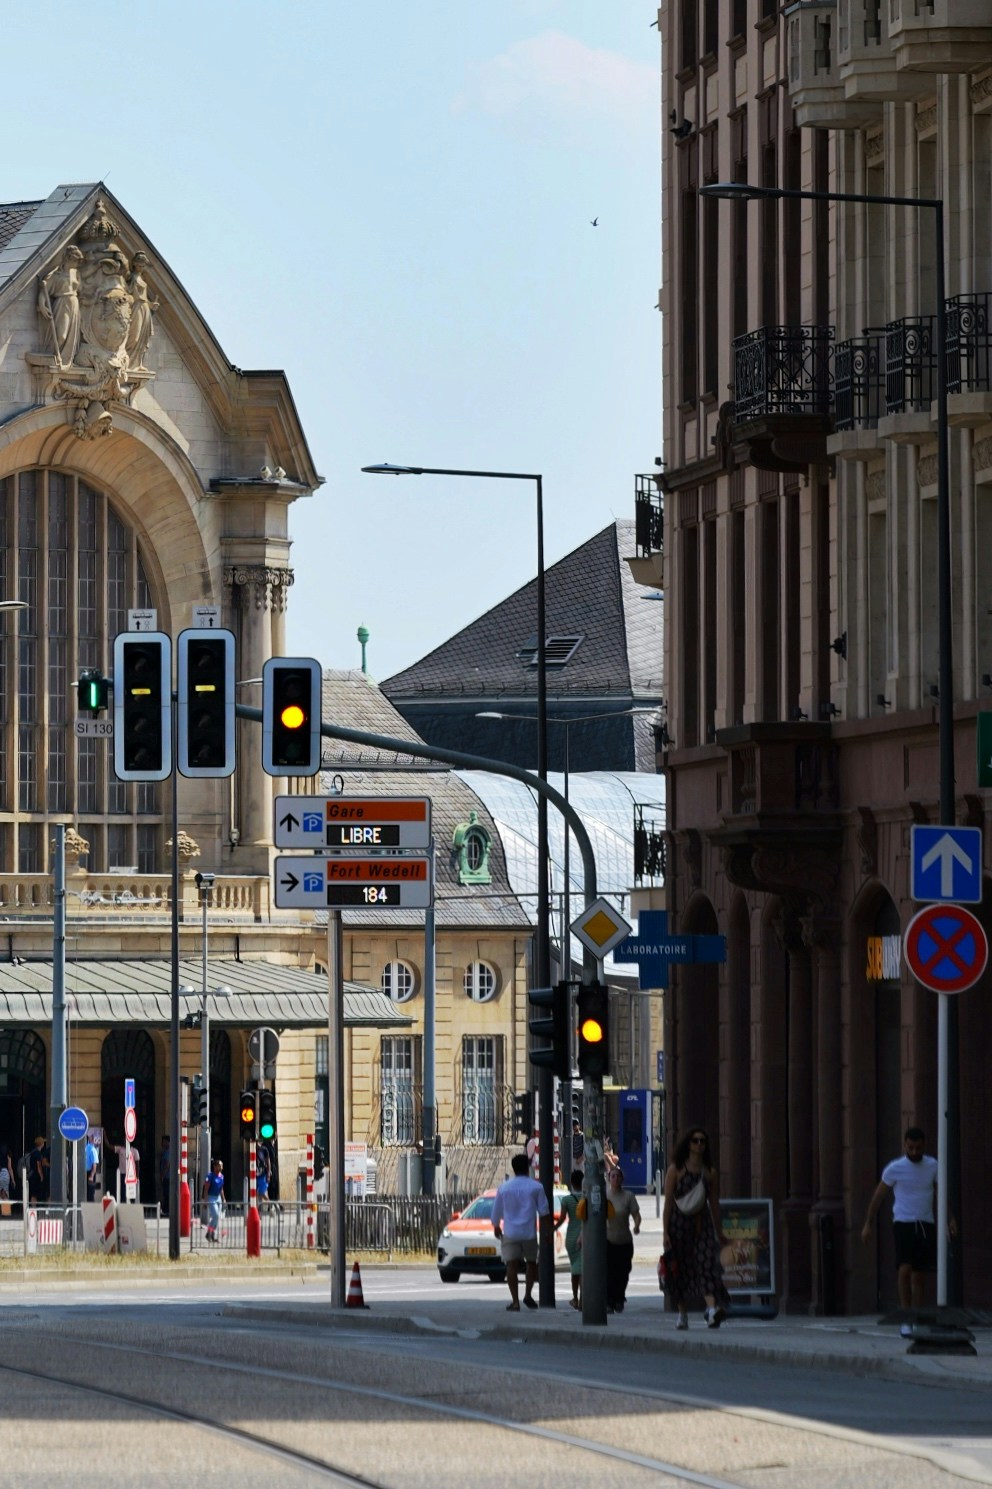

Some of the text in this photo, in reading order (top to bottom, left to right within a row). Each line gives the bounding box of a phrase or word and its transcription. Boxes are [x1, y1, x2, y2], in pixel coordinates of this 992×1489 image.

[76, 722, 113, 735] SI 130
[329, 804, 364, 818] Gare
[309, 819, 318, 831] P
[341, 827, 382, 843] LIBRE
[330, 864, 420, 877] Fort Wedell
[309, 879, 319, 891] P
[362, 887, 388, 903] 184
[620, 944, 687, 955] LABORATOIRE
